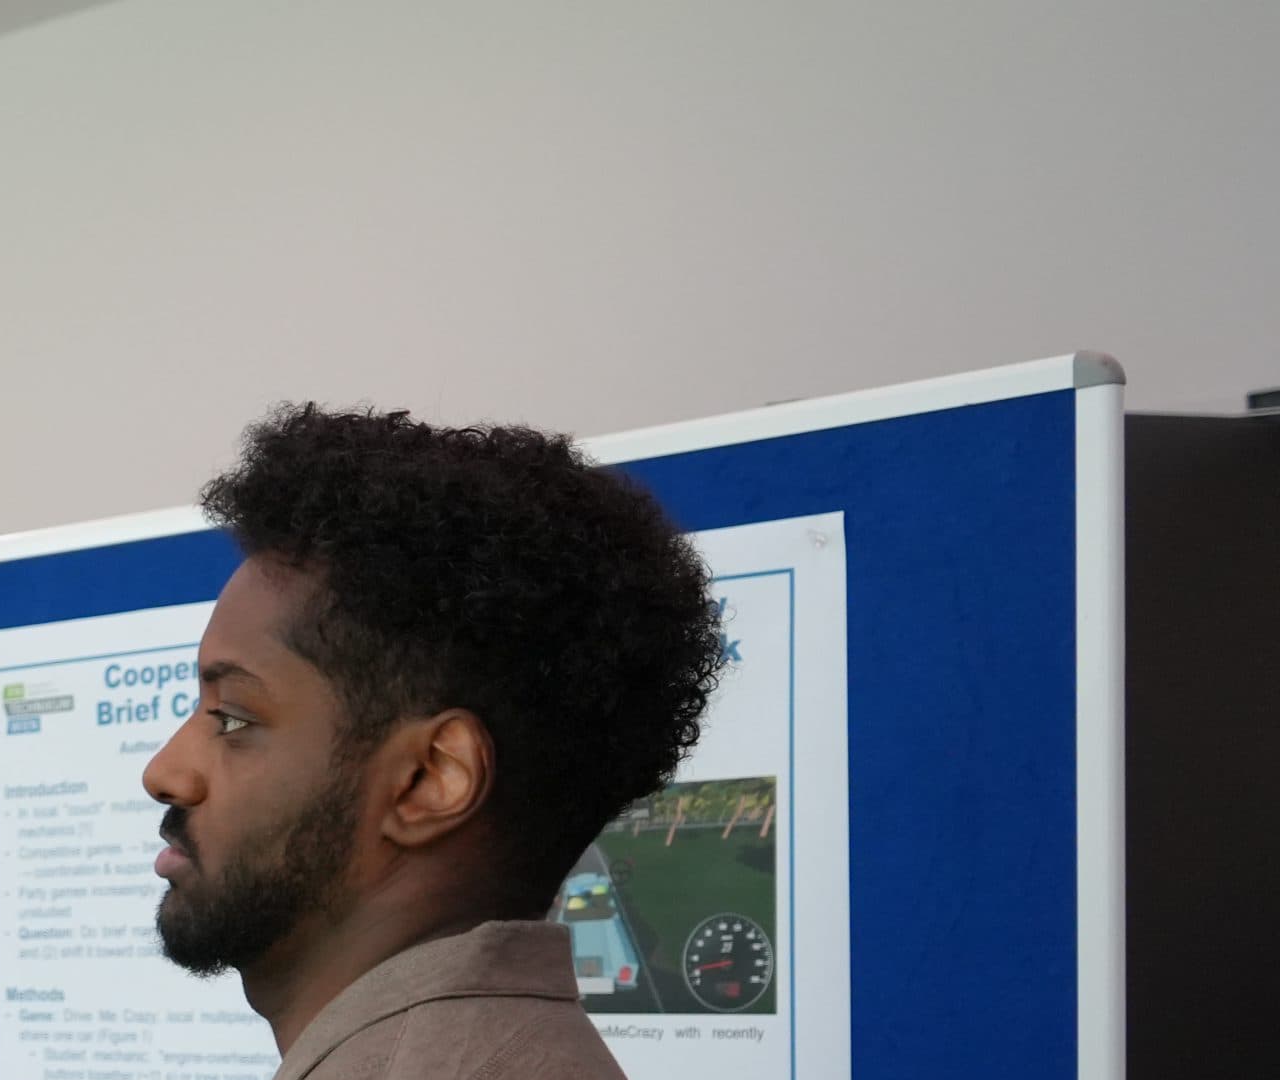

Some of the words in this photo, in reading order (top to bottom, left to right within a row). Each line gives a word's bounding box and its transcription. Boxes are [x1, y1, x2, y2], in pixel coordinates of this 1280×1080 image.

[96, 694, 161, 726] Brief
[4, 779, 89, 799] Introduction
[6, 985, 66, 1002] Methods
[675, 1026, 701, 1040] with
[712, 1025, 765, 1043] recently
